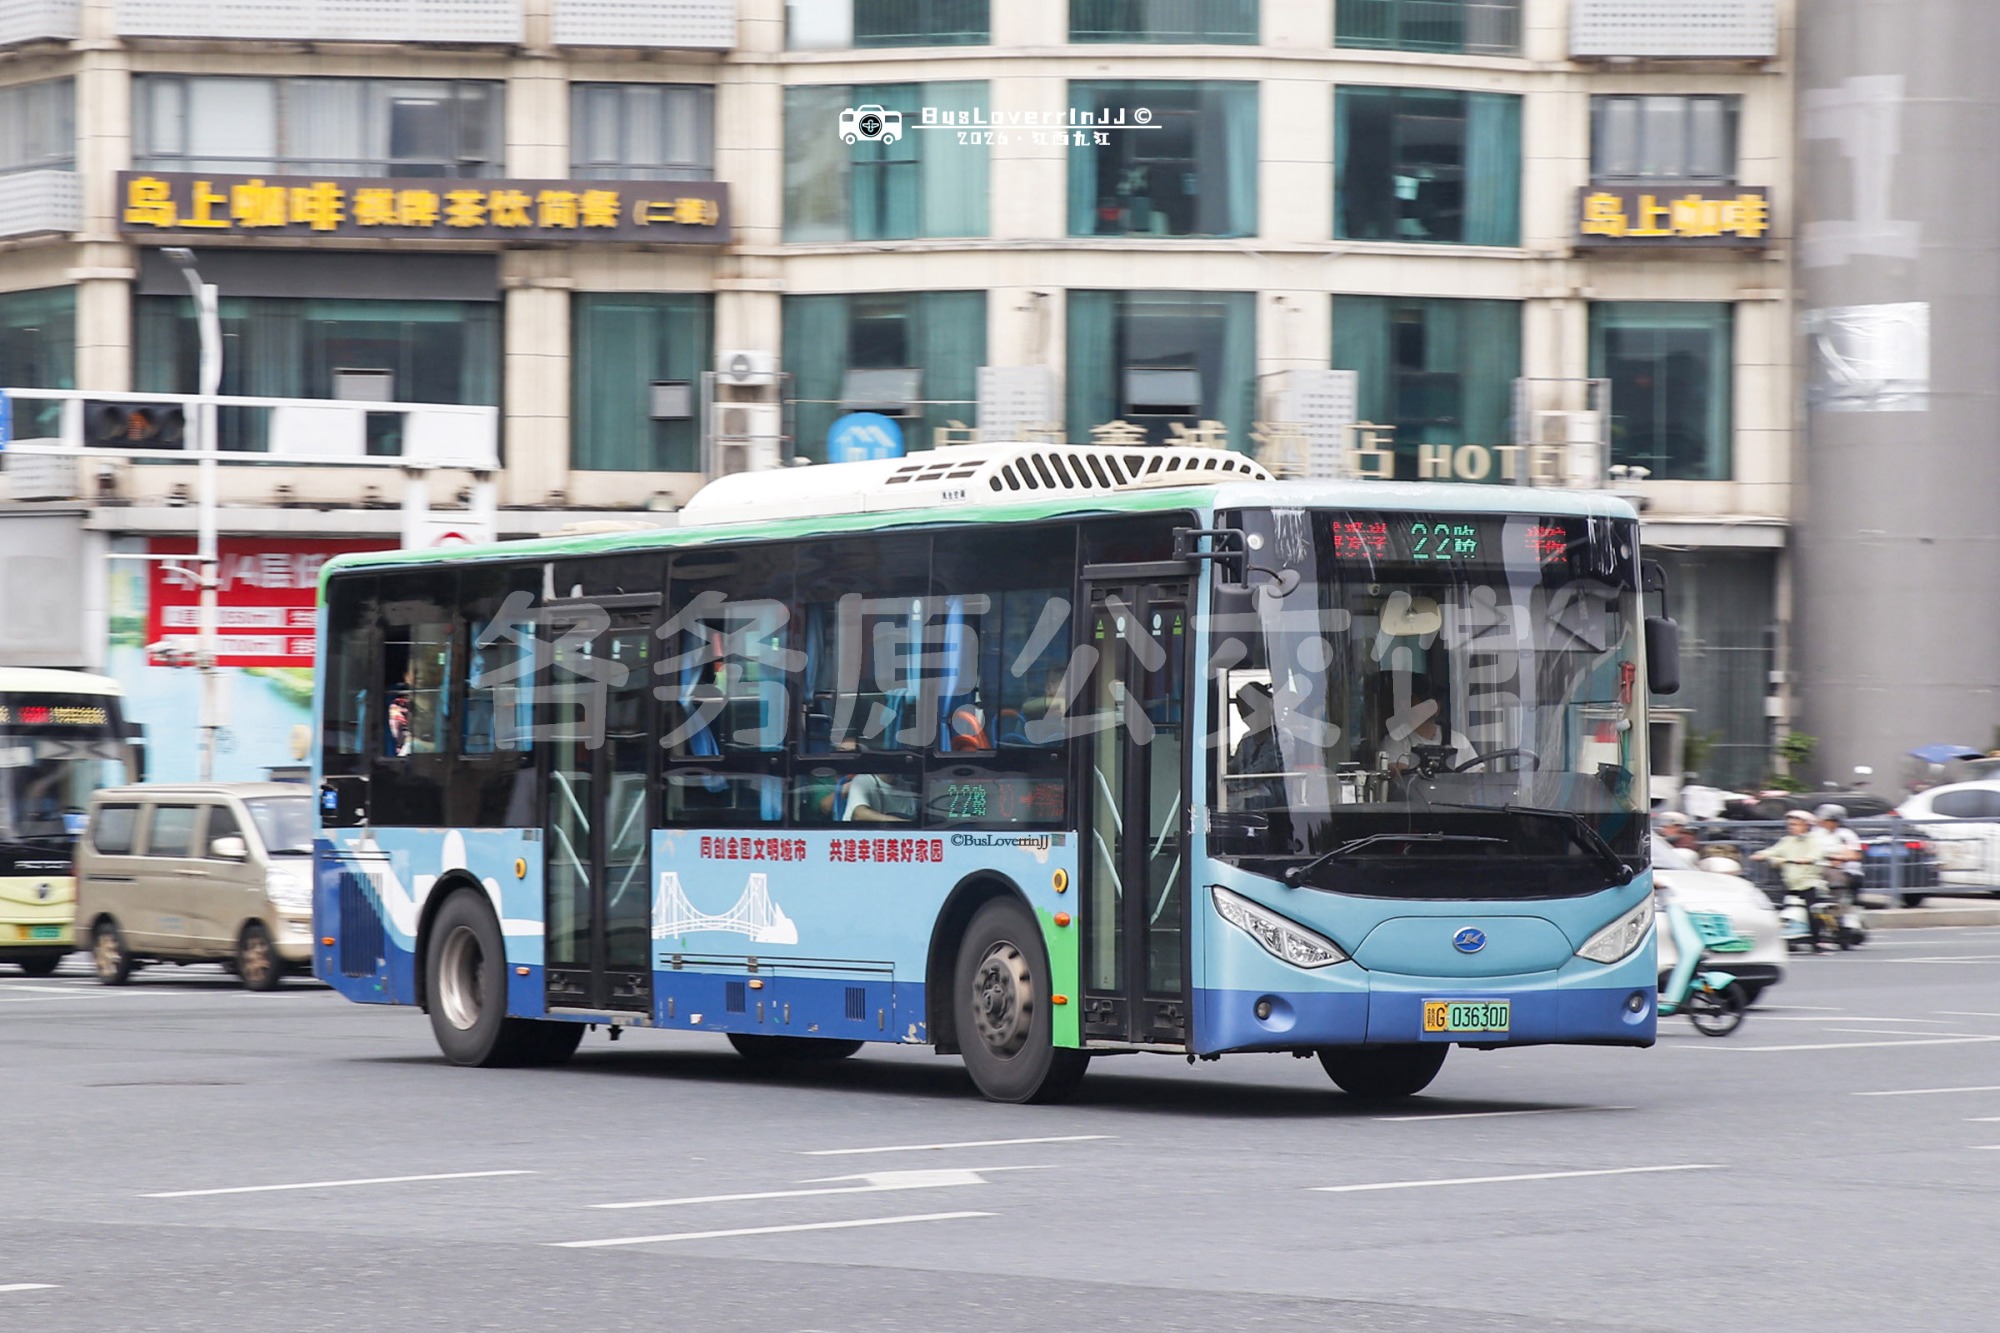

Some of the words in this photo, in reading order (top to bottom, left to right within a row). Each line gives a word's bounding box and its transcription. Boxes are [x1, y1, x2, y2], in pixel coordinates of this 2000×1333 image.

[700, 836, 807, 861] 同创全国文明城市
[829, 838, 943, 863] 共建幸福美好家园
